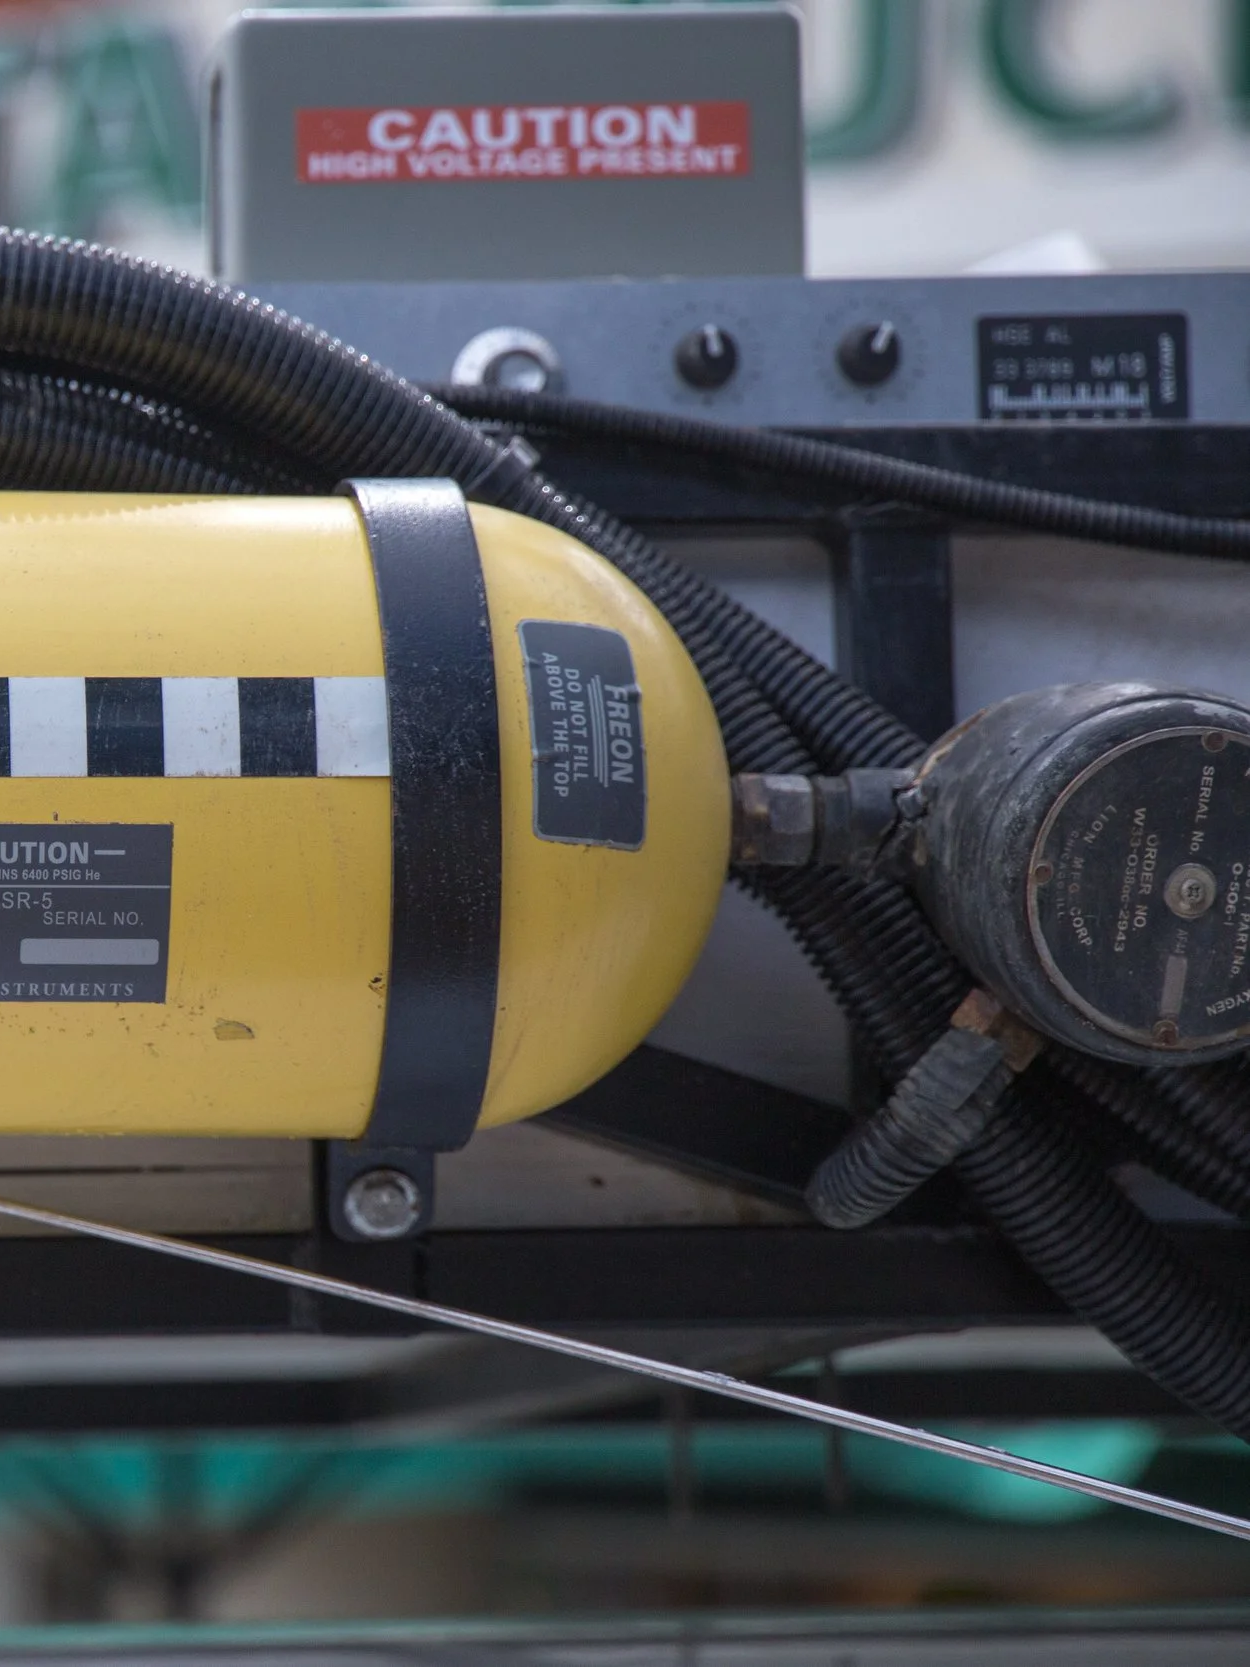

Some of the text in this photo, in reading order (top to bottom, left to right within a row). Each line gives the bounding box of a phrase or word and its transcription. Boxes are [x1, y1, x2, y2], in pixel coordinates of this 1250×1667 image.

[367, 105, 697, 151] CAUTION
[308, 144, 740, 178] HIGH VOLTAGE PRESENT
[542, 651, 570, 798] ABOVE THE TOP
[565, 668, 589, 782] DO NOT FILL
[604, 684, 635, 784] FREON
[1195, 766, 1215, 823] SERIAL
[1083, 804, 1117, 844] LION
[22, 869, 49, 881] 6400
[53, 869, 82, 881] PSIG
[85, 869, 101, 881] He
[1132, 834, 1159, 931] ORDER NO.
[43, 911, 145, 926] SERIAL NO.
